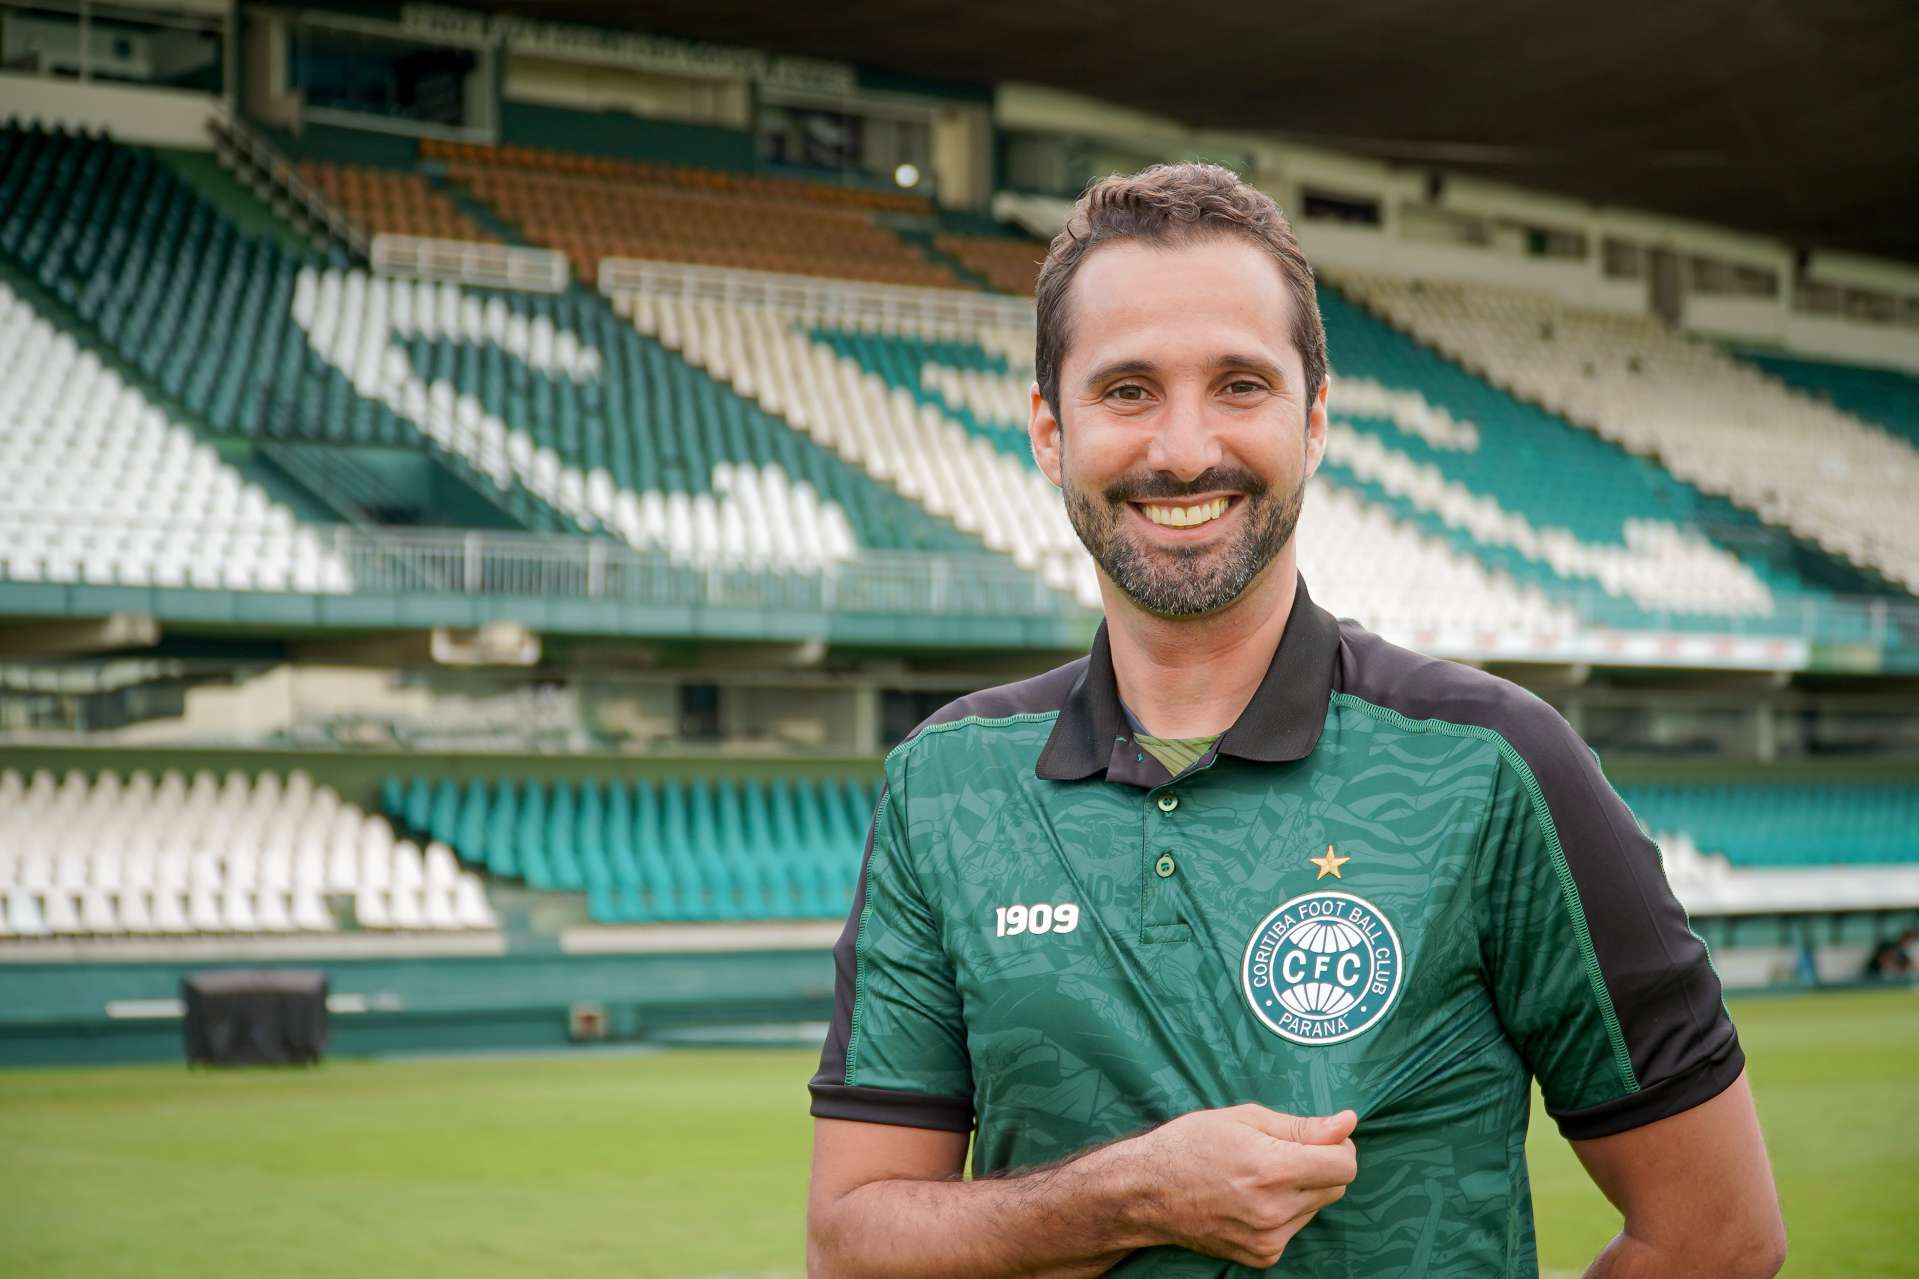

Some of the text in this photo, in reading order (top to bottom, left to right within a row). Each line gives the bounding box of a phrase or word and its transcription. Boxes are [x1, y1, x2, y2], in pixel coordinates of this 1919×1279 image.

[996, 904, 1080, 937] 1909
[1253, 900, 1391, 995] CORITIBA FOOT BALL CLUB
[1282, 950, 1361, 987] CFC
[1279, 1012, 1349, 1037] PARANÁ
